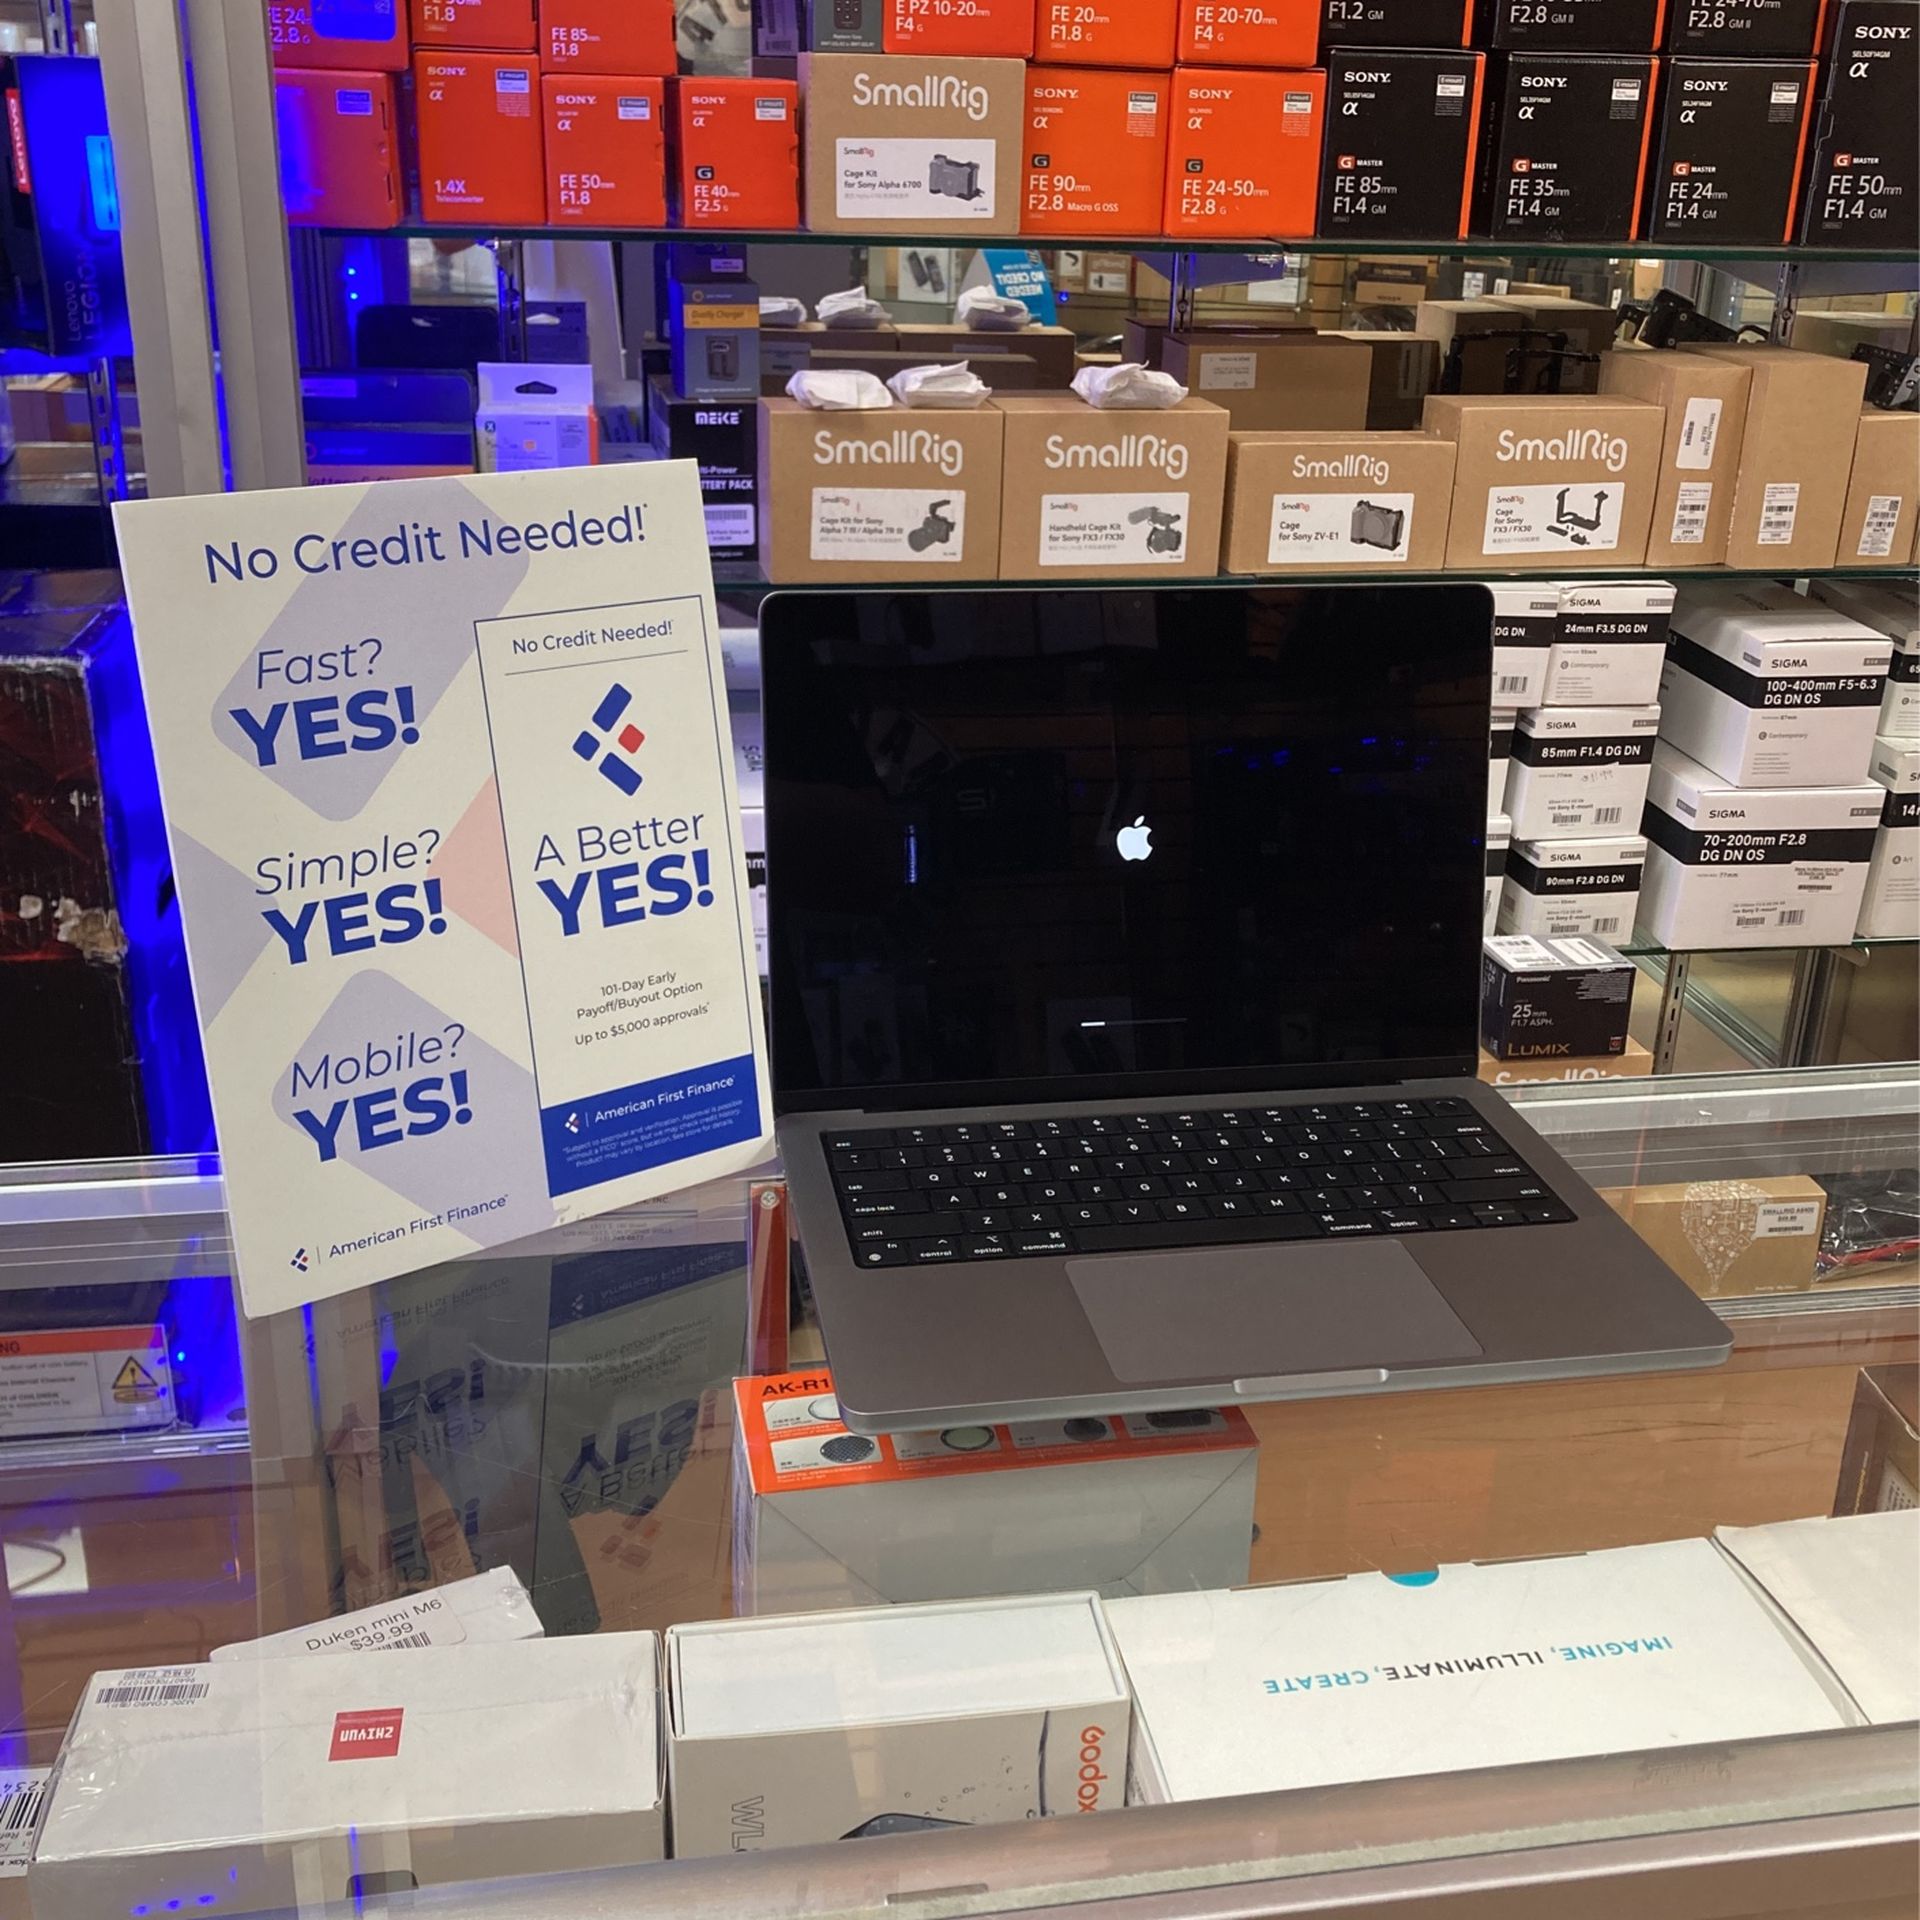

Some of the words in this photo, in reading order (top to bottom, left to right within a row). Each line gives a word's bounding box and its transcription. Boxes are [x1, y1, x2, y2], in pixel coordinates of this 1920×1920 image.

[424, 5, 455, 22] F1.8
[1052, 6, 1069, 20] FE
[1075, 7, 1109, 22] 20mm
[1196, 6, 1213, 22] FE
[1218, 8, 1277, 24] 20-70mm
[1328, 2, 1362, 19] F1.2
[1368, 11, 1383, 20] GM
[1855, 26, 1911, 39] SONY
[552, 43, 579, 57] F1.8
[428, 67, 466, 76] SONY
[1344, 71, 1391, 83] SONY
[1521, 76, 1567, 88] SONY
[1683, 80, 1728, 91] SONY
[555, 94, 597, 104] SONY
[691, 96, 726, 105] SONY
[852, 73, 989, 121] SmallRig
[1034, 89, 1078, 99] SONY
[1188, 90, 1232, 100] SONY
[9, 96, 28, 186] Lenovo
[844, 147, 874, 157] SmallRig
[1357, 159, 1383, 167] MASTER
[1532, 162, 1557, 170] MASTER
[1853, 157, 1879, 165] MASTER
[844, 169, 866, 180] Cage
[867, 169, 877, 178] Kit
[434, 180, 466, 193] 1.4X
[844, 180, 856, 190] for
[857, 180, 875, 193] Sony
[879, 180, 900, 193] Alpha
[903, 180, 922, 190] 6700
[1029, 175, 1048, 190] FE
[1053, 175, 1091, 192] 90mm
[1183, 180, 1201, 195] FE
[1206, 180, 1269, 196] 24-50mm
[1335, 176, 1354, 192] FE
[1359, 176, 1397, 194] 85mm
[1510, 179, 1529, 196] FE
[1533, 179, 1570, 197] 35mm
[1669, 182, 1689, 199] FE
[1692, 182, 1728, 199] 24mm
[1828, 175, 1852, 195] FE
[1857, 175, 1902, 195] 50mm
[560, 190, 591, 205] F1.8
[694, 200, 721, 212] F2.5
[1333, 197, 1367, 213] F1.4
[1371, 205, 1386, 213] GM
[1507, 199, 1541, 216] F1.4
[1545, 207, 1559, 216] GM
[1666, 202, 1698, 219] F1.4
[1703, 210, 1717, 219] GM
[1824, 199, 1864, 219] F1.4
[1869, 208, 1887, 219] GM
[64, 280, 80, 343] Lenovo
[695, 411, 739, 425] MEIKE
[814, 430, 962, 476] SmallRig
[1045, 434, 1188, 480] SmallRig
[1496, 429, 1628, 472] SmallRig
[1293, 454, 1390, 486] SmallRig
[730, 480, 753, 490] PACK
[820, 517, 838, 527] Cage
[840, 517, 851, 526] Kit
[866, 517, 883, 527] Sony
[1496, 509, 1513, 519] Cage
[1048, 523, 1085, 533] Handheld
[1088, 523, 1106, 534] Cage
[1108, 523, 1121, 532] Kit
[1280, 521, 1300, 532] Cage
[1279, 531, 1291, 541] for
[1293, 532, 1311, 544] Sony
[1314, 531, 1339, 541] ZV-E1
[204, 541, 279, 583] No
[294, 522, 445, 574] Credit
[1570, 599, 1600, 607] SIGMA
[1565, 624, 1594, 634] 24mm
[1596, 624, 1615, 634] F3.5
[1617, 624, 1631, 634] DG
[1633, 623, 1648, 633] DN
[512, 637, 537, 655] No
[542, 629, 598, 652] Credit
[256, 637, 383, 689] Fast?
[1771, 659, 1808, 668] SIGMA
[1767, 680, 1836, 692] 100-400mm
[1838, 679, 1877, 691] F5-6.3
[1764, 695, 1781, 705] DG
[1784, 694, 1801, 704] DN
[1804, 694, 1821, 704] OS
[228, 685, 420, 767] YES!
[1541, 747, 1576, 758] 85mm
[1580, 747, 1602, 757] F1.4
[1605, 746, 1622, 756] DG
[1624, 745, 1640, 755] DN
[1709, 810, 1745, 819] SIGMA
[533, 834, 565, 872] A
[577, 811, 705, 862] Better
[1704, 835, 1776, 846] 70-200mm
[1779, 833, 1807, 845] F2.8
[255, 828, 441, 895] Simple?
[1551, 854, 1581, 862] SIGMA
[1700, 850, 1719, 861] DG
[1723, 849, 1743, 861] DN
[1746, 849, 1765, 860] OS
[536, 848, 714, 937] YES!
[261, 877, 448, 965] YES!
[601, 980, 644, 997] 101-Day
[648, 971, 676, 986] Early
[577, 990, 660, 1019] Payoff/Buyout
[663, 981, 703, 999] Option
[575, 1030, 593, 1046] Up
[596, 1029, 608, 1040] to
[610, 1018, 650, 1037] $5,000
[1508, 1043, 1570, 1056] LUMIX
[290, 1023, 466, 1097] Mobile?
[595, 1099, 655, 1123] American
[657, 1091, 684, 1105] First
[292, 1069, 474, 1163] YES!
[329, 1223, 405, 1259] American
[409, 1214, 444, 1236] First
[974, 1247, 1003, 1255] option
[1022, 1242, 1066, 1251] command
[1330, 1223, 1372, 1232] command
[1390, 1220, 1418, 1228] option
[762, 1378, 829, 1397] AK-R1
[306, 1625, 367, 1651] Duken
[371, 1610, 409, 1629] mini
[412, 1599, 442, 1615] M6
[350, 1622, 413, 1650] $39.99
[1549, 1635, 1673, 1662] IMAGINE,
[1374, 1650, 1543, 1681] ILLUMINATE,
[1263, 1669, 1369, 1694] CREATE
[339, 1726, 395, 1743] ZHIYUN
[1077, 1725, 1106, 1813] Godox
